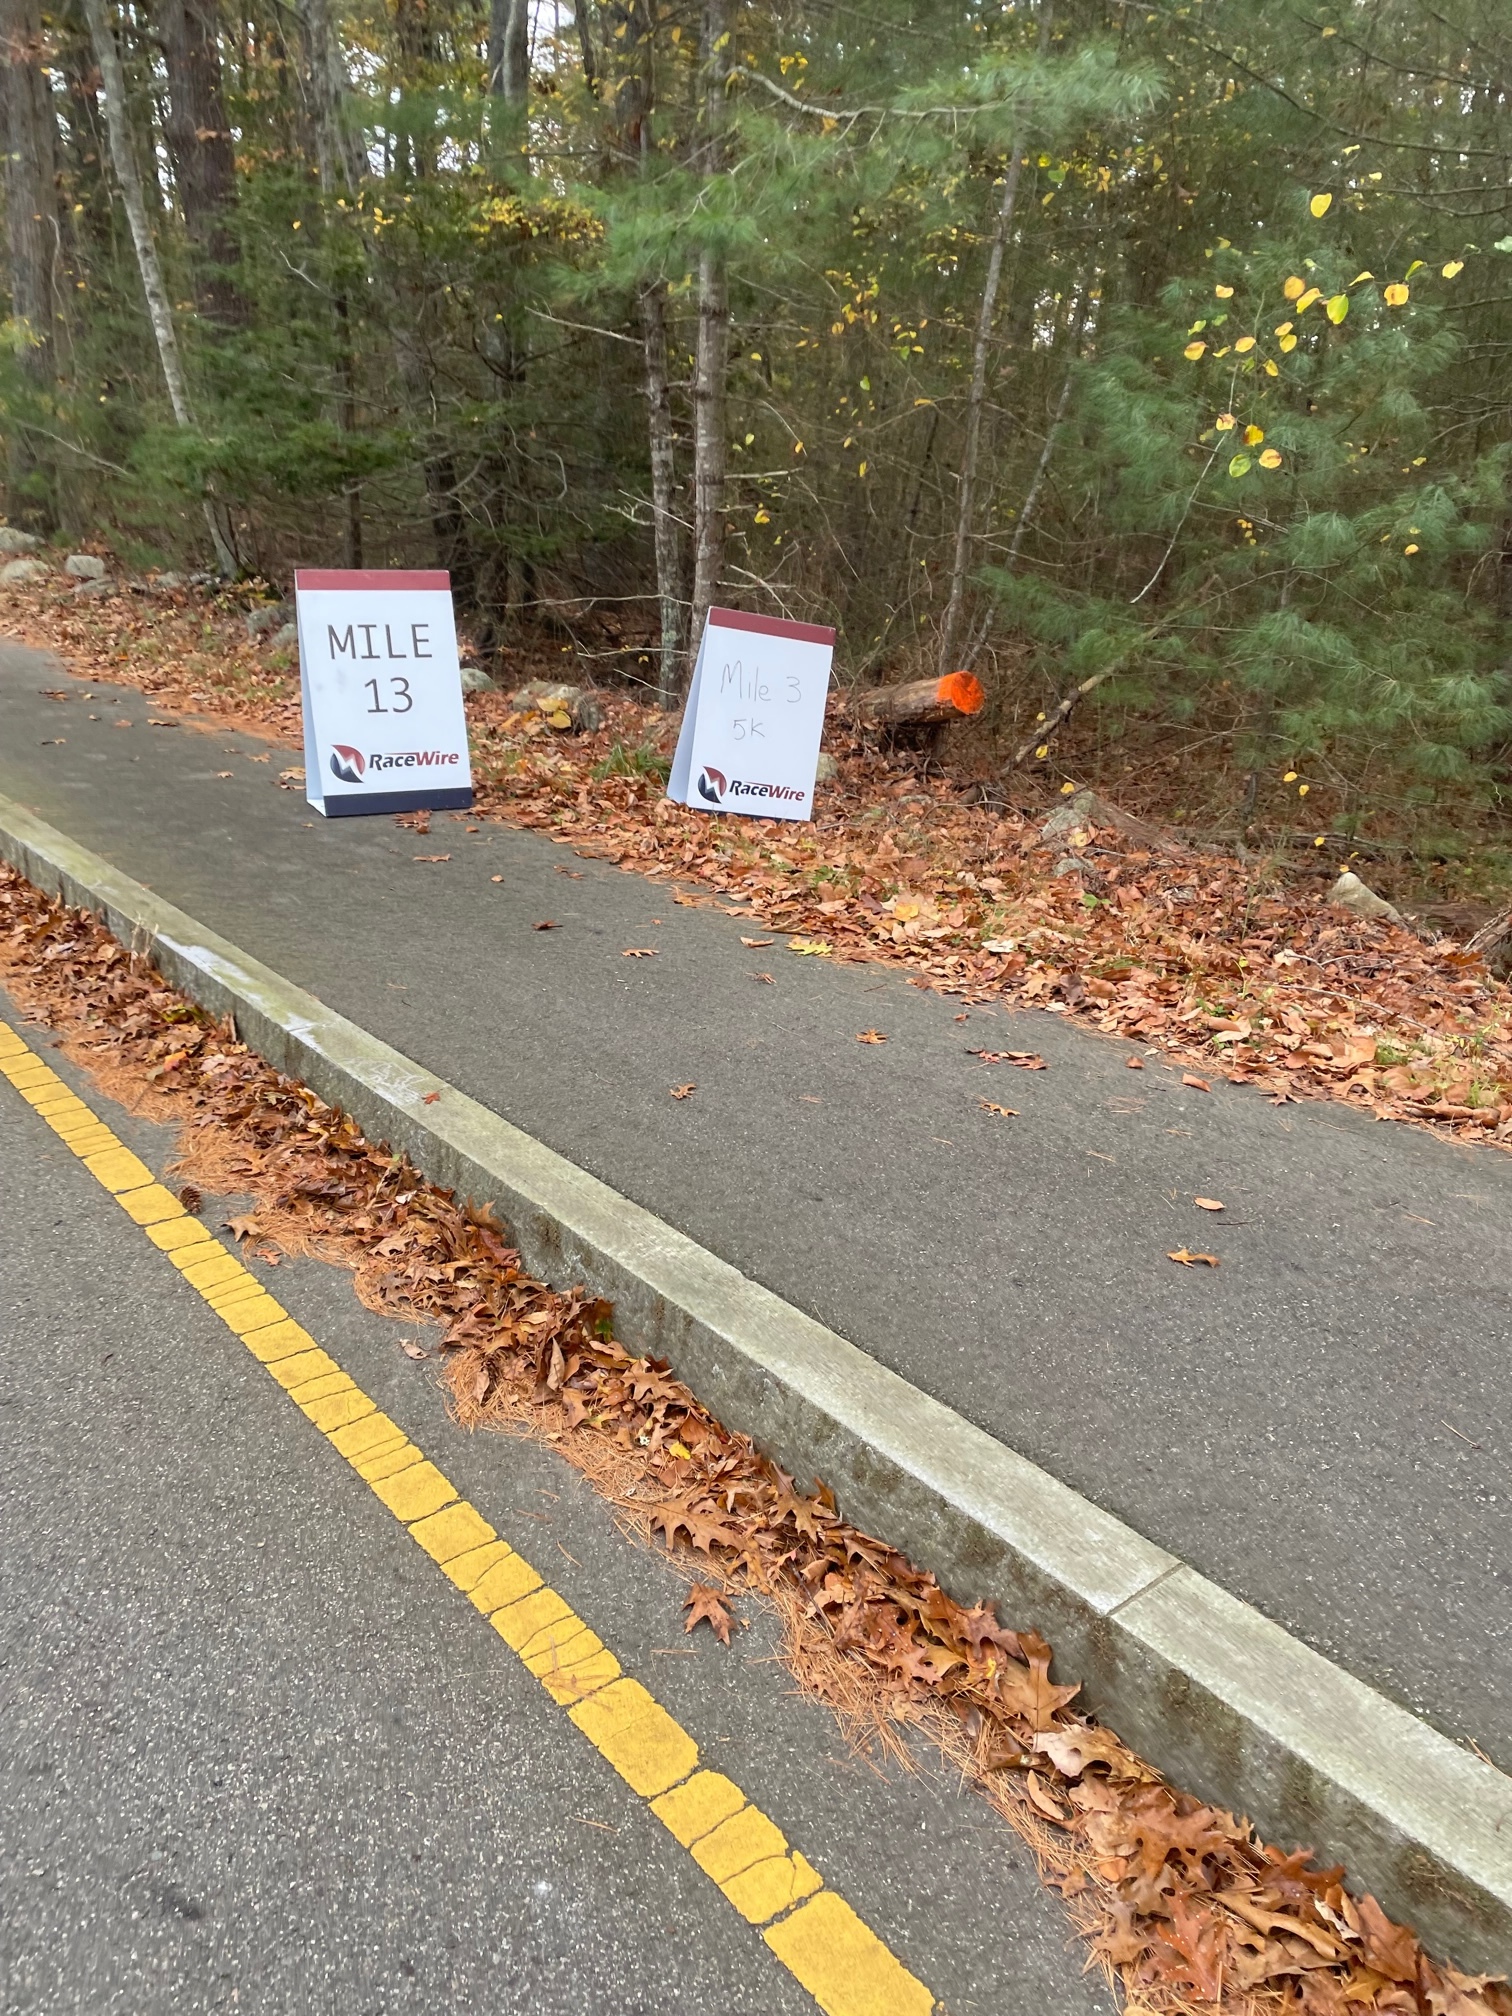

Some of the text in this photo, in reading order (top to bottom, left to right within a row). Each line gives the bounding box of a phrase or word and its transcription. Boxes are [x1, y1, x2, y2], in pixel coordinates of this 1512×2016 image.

[327, 624, 432, 660] MILE
[364, 677, 413, 713] 13
[720, 660, 802, 703] Mile 3
[369, 750, 460, 771] RaceWire
[729, 780, 805, 801] RaceWire
